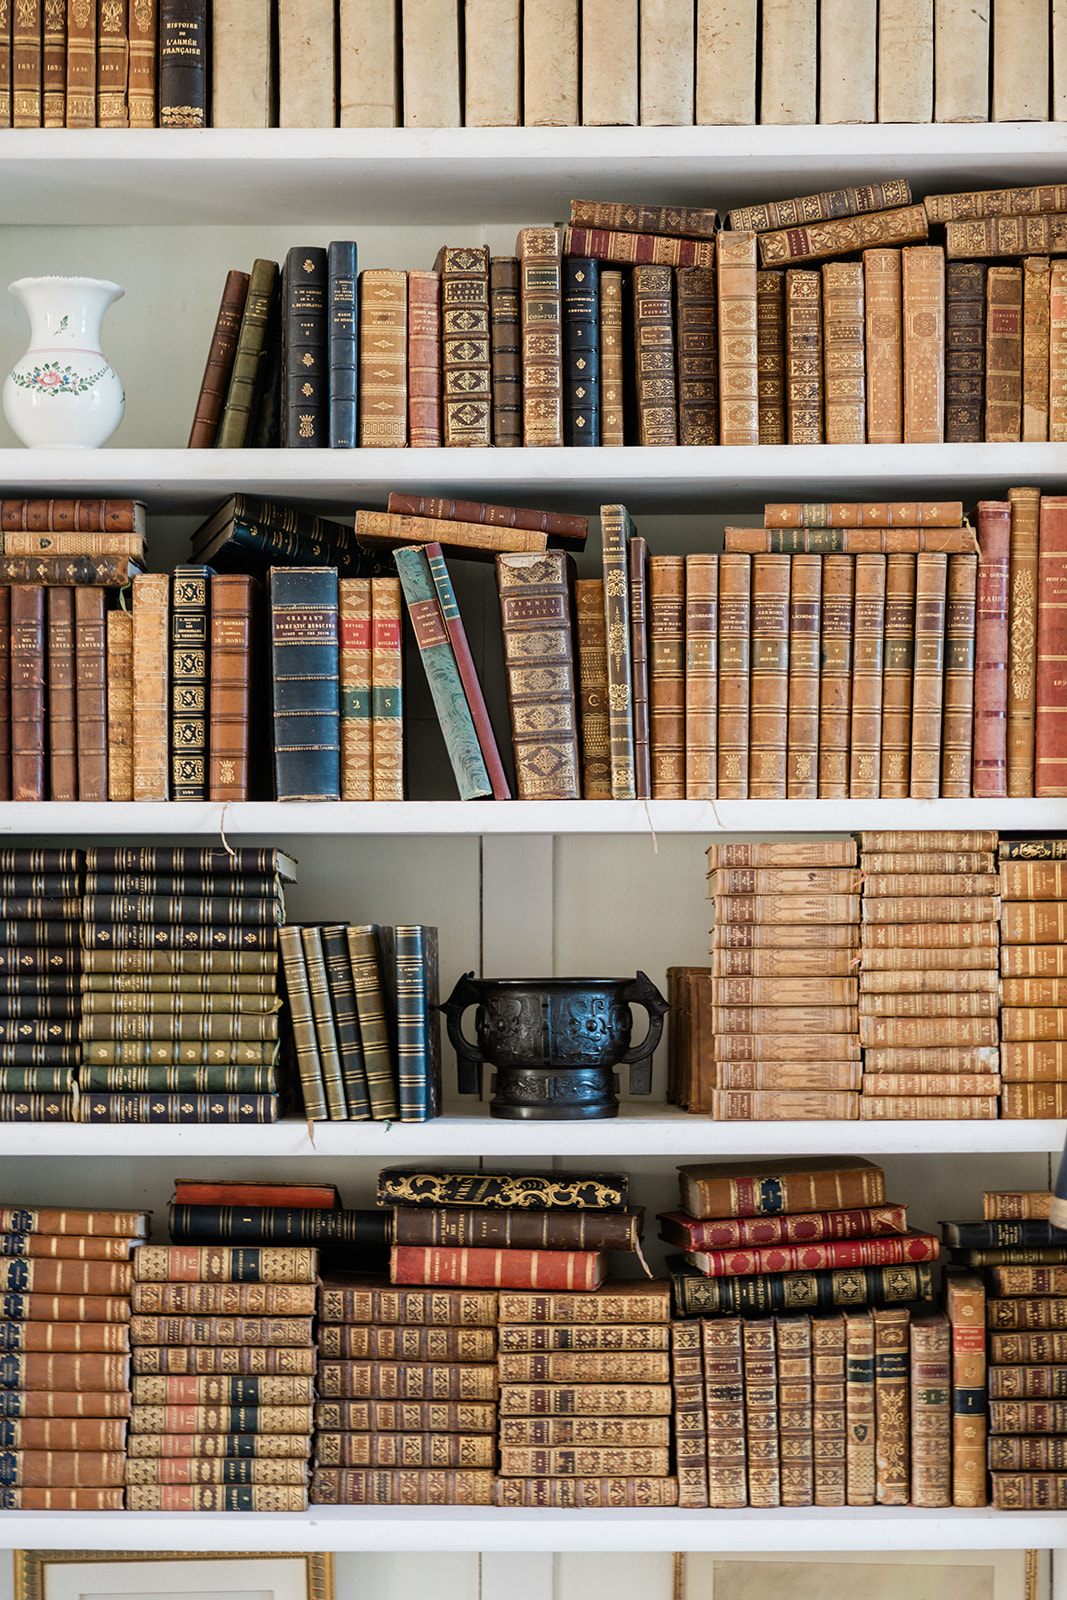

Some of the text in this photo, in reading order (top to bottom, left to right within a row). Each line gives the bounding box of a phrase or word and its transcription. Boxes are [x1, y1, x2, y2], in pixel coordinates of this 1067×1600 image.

[167, 22, 198, 30] HISTOIRE
[166, 38, 197, 46] L'ARMÉE
[162, 47, 201, 56] FRANÇAISE
[538, 303, 544, 311] 3
[352, 700, 361, 709] 2
[982, 928, 990, 938] 12
[1047, 1095, 1055, 1106] 10
[454, 1179, 474, 1200] PARIS
[856, 1428, 864, 1436] 2
